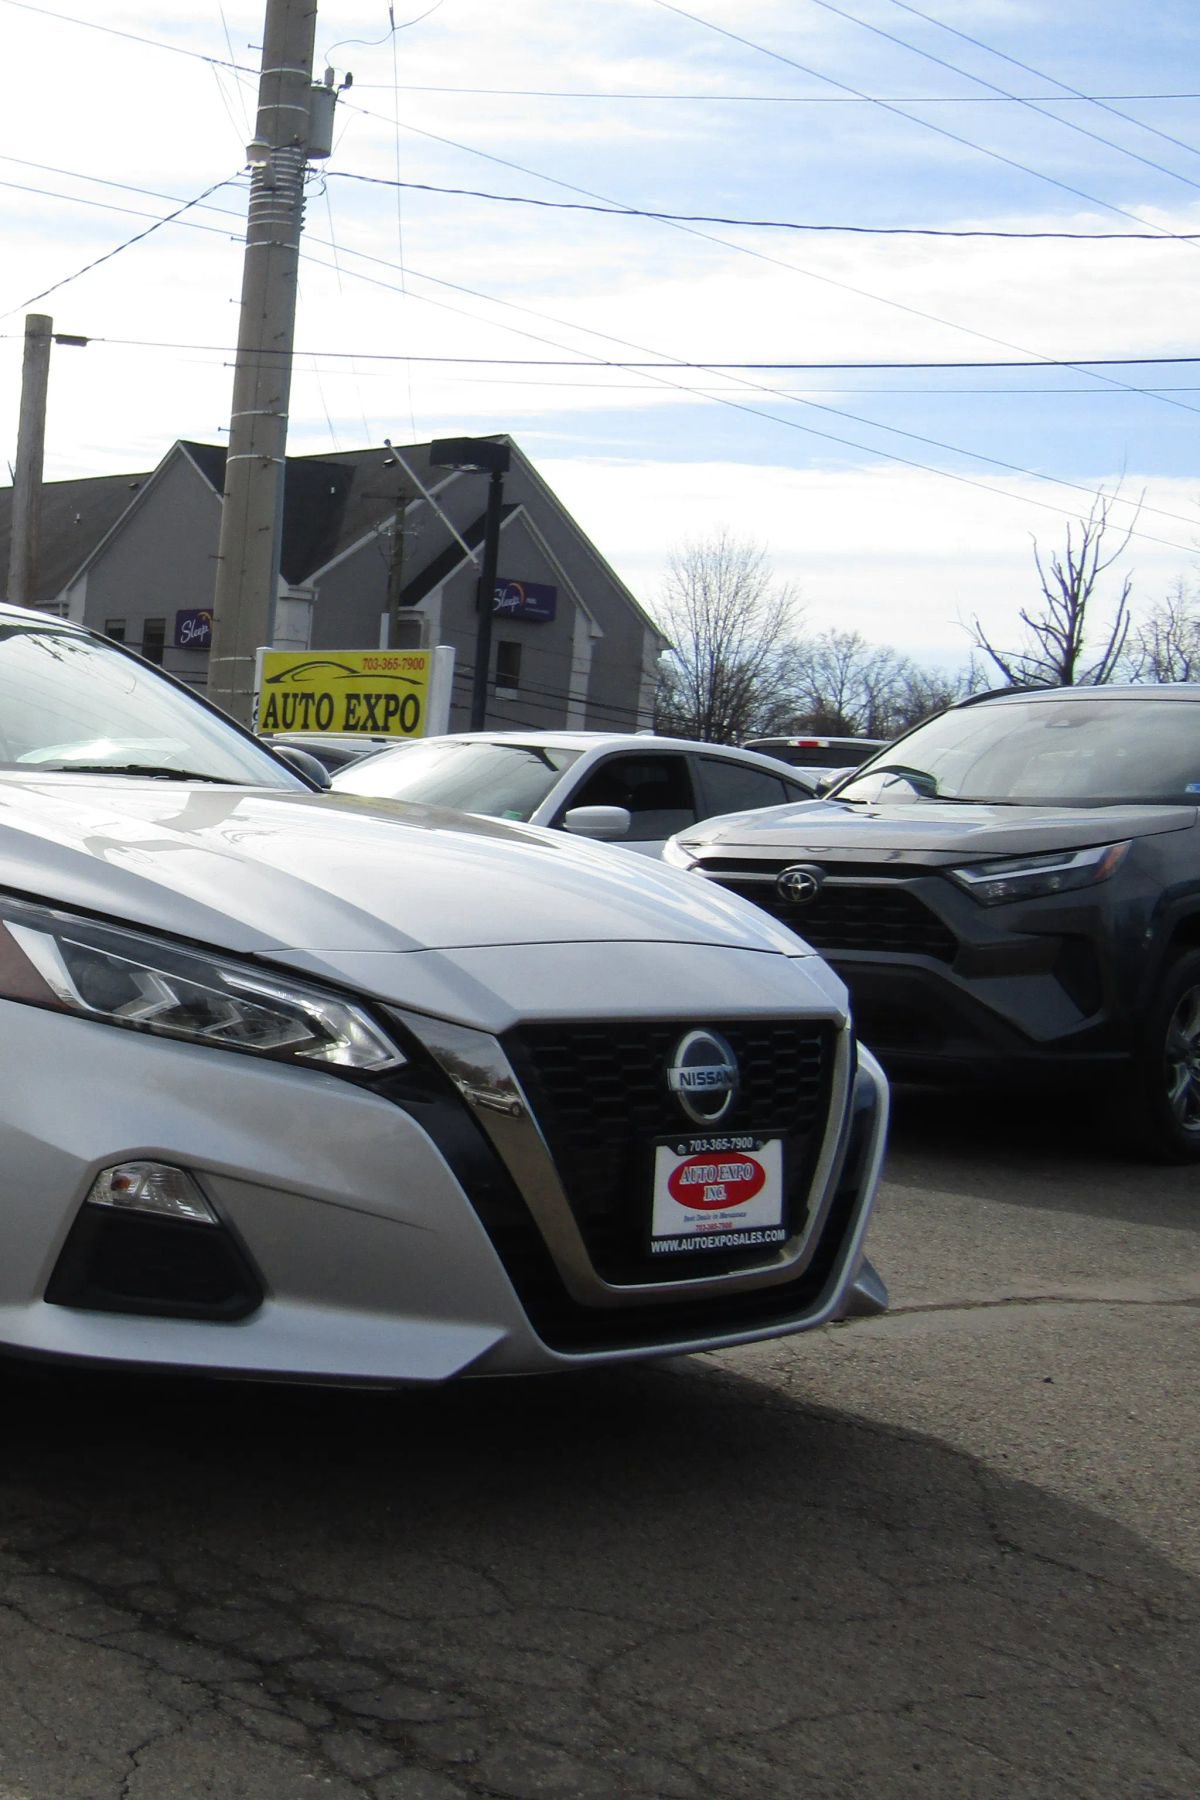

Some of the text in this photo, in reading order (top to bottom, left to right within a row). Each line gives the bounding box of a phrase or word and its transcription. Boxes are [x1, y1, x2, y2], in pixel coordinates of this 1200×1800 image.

[362, 657, 425, 671] 703-365-7900
[262, 691, 335, 731] AUTO
[342, 692, 421, 733] EXPO
[679, 1069, 733, 1086] NISSAN
[689, 1136, 753, 1152] 703-365-7900
[679, 1162, 755, 1185] AUTO EXPO
[651, 1228, 786, 1253] WWW.AUTOEXPOSALES.COM
